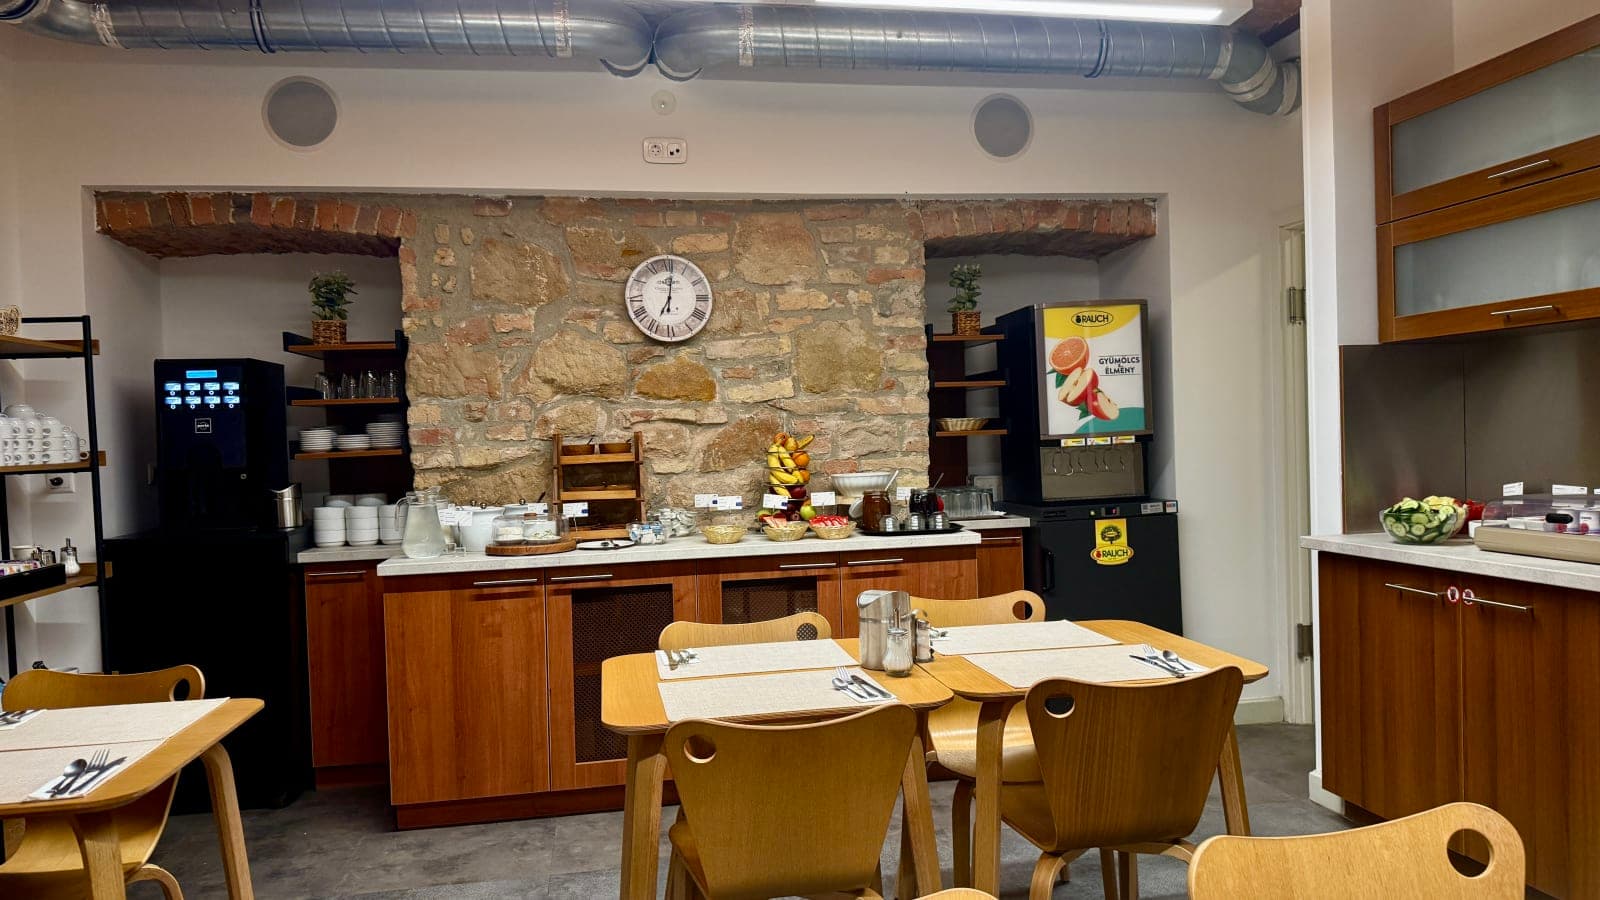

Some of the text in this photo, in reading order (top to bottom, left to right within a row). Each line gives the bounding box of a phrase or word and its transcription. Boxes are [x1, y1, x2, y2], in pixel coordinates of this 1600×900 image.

[1082, 314, 1109, 323] RAUCH
[1098, 355, 1140, 365] GYÜMÖLCS
[1105, 366, 1135, 375] ÉLMÉNY
[1102, 549, 1128, 558] RAUCH
